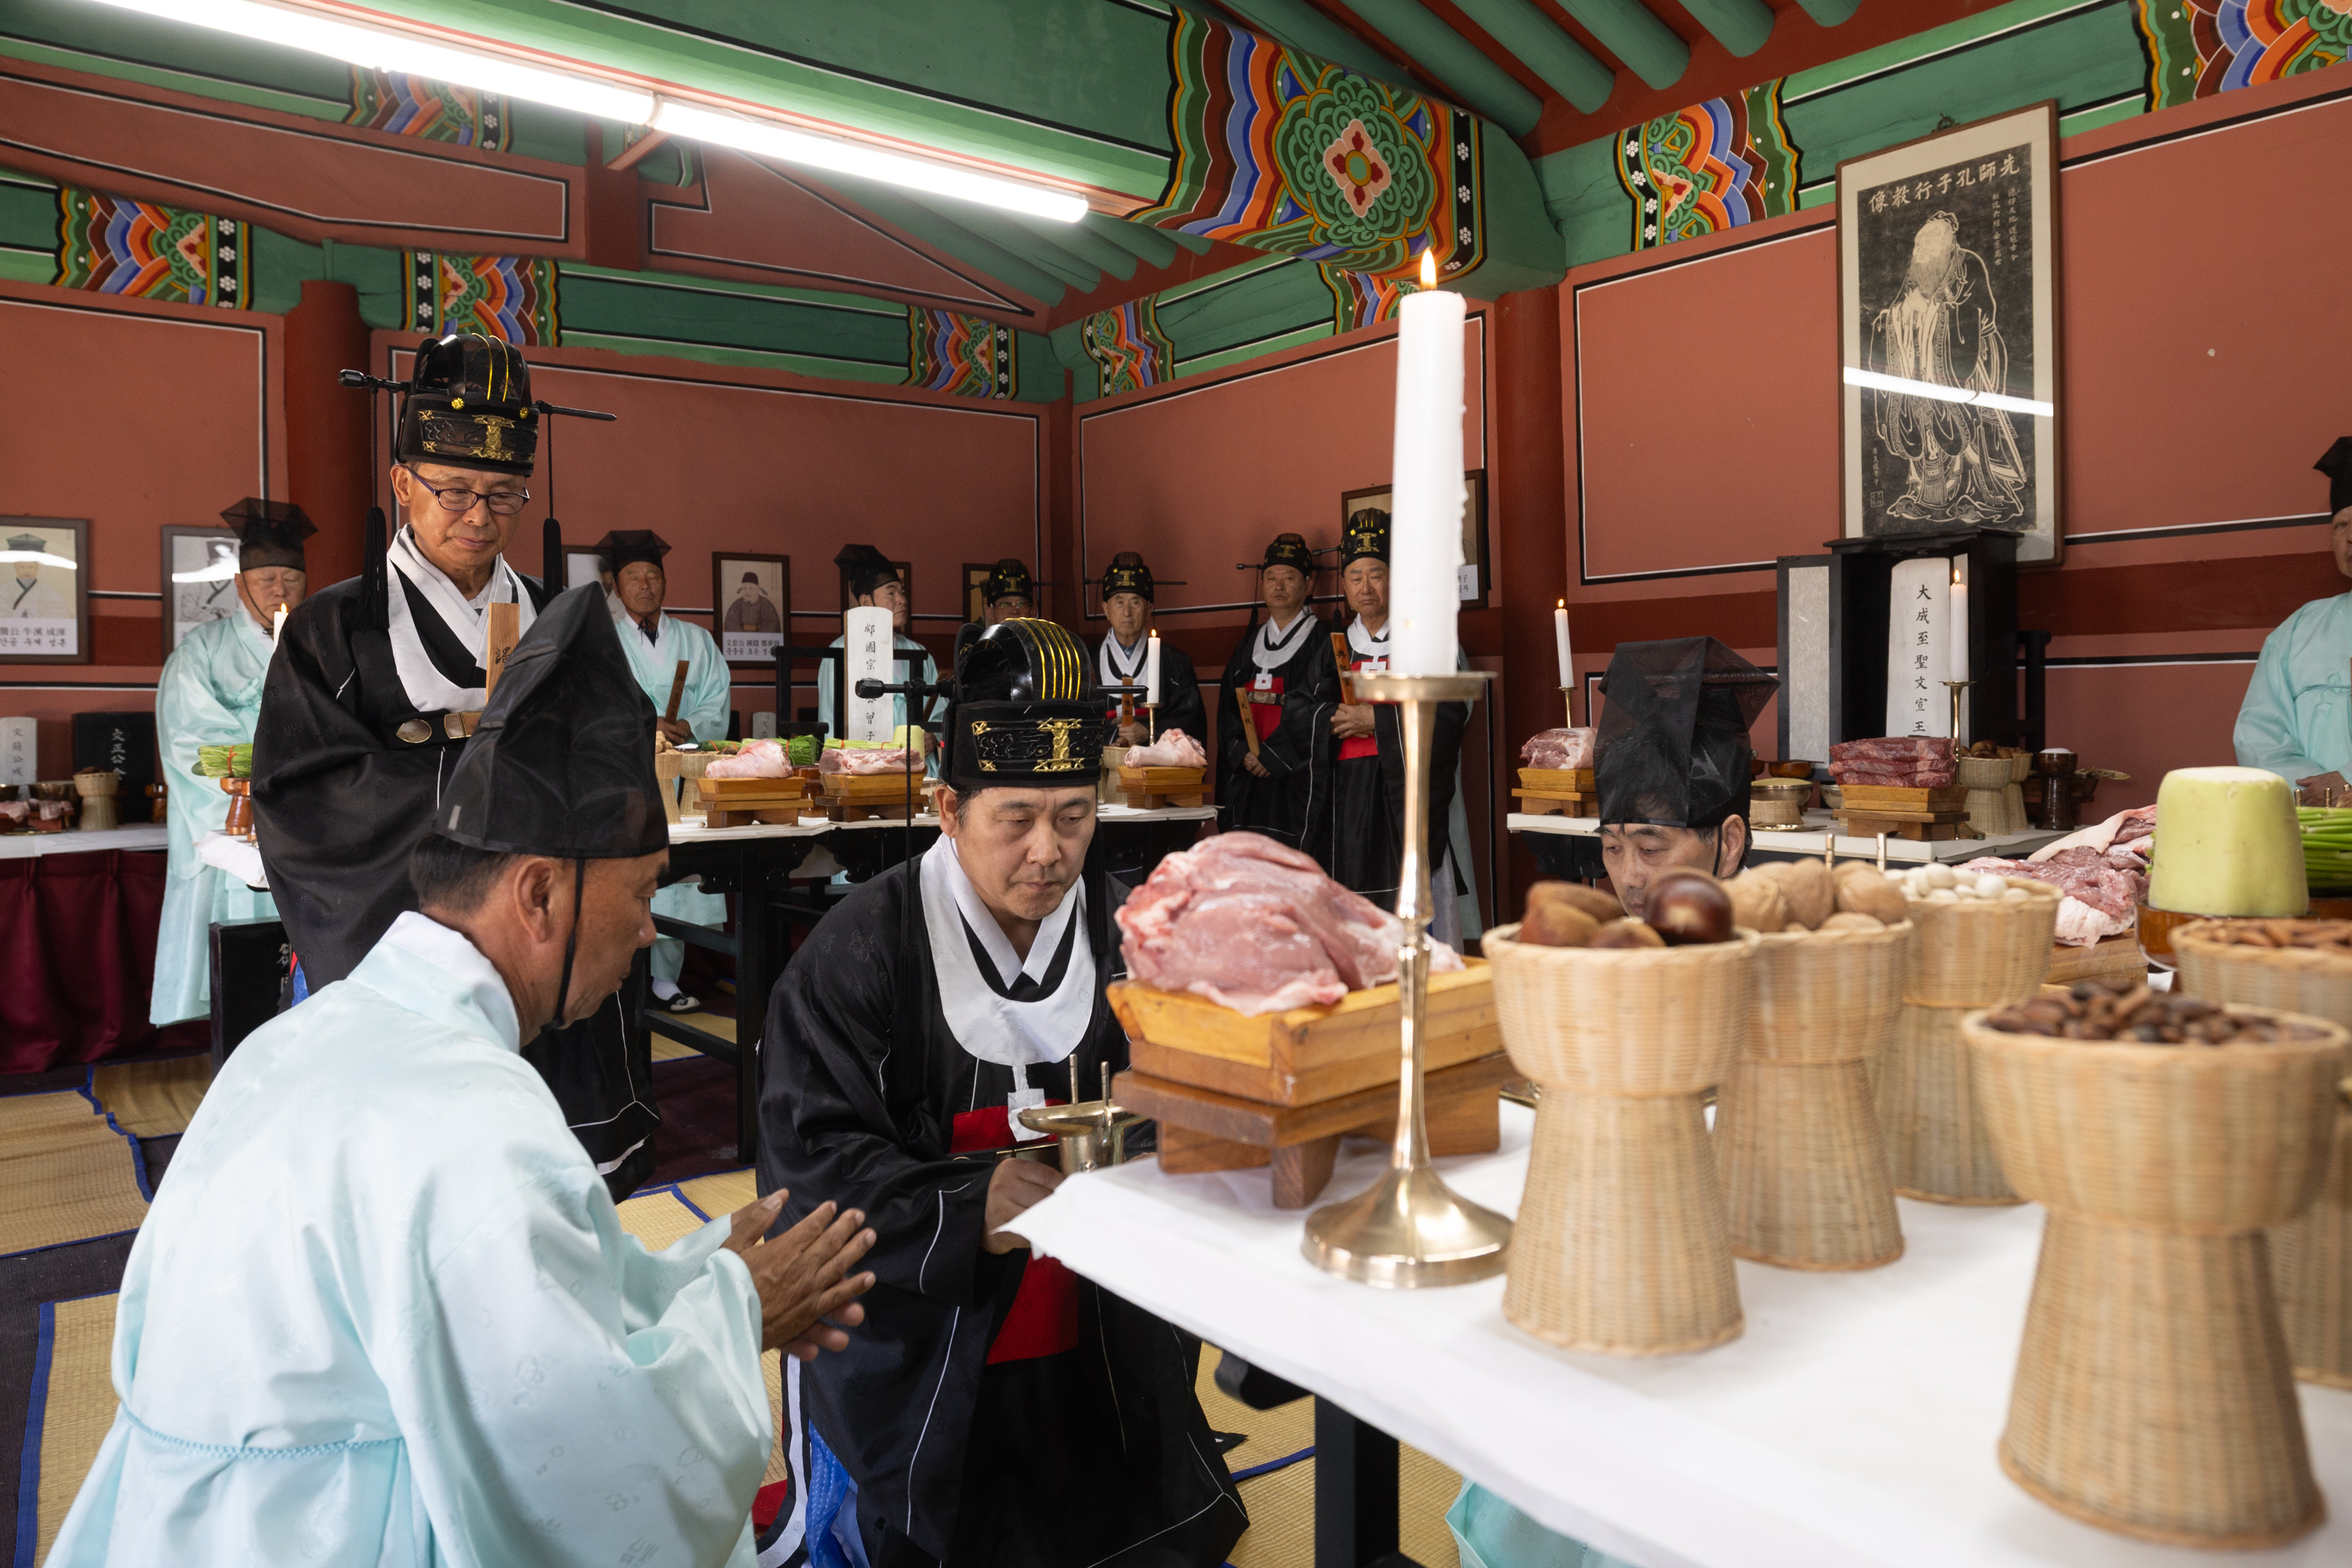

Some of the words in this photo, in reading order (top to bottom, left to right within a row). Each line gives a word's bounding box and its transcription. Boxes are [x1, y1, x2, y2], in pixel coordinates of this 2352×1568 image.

[1913, 584, 1932, 732] 大成至聖文宣王
